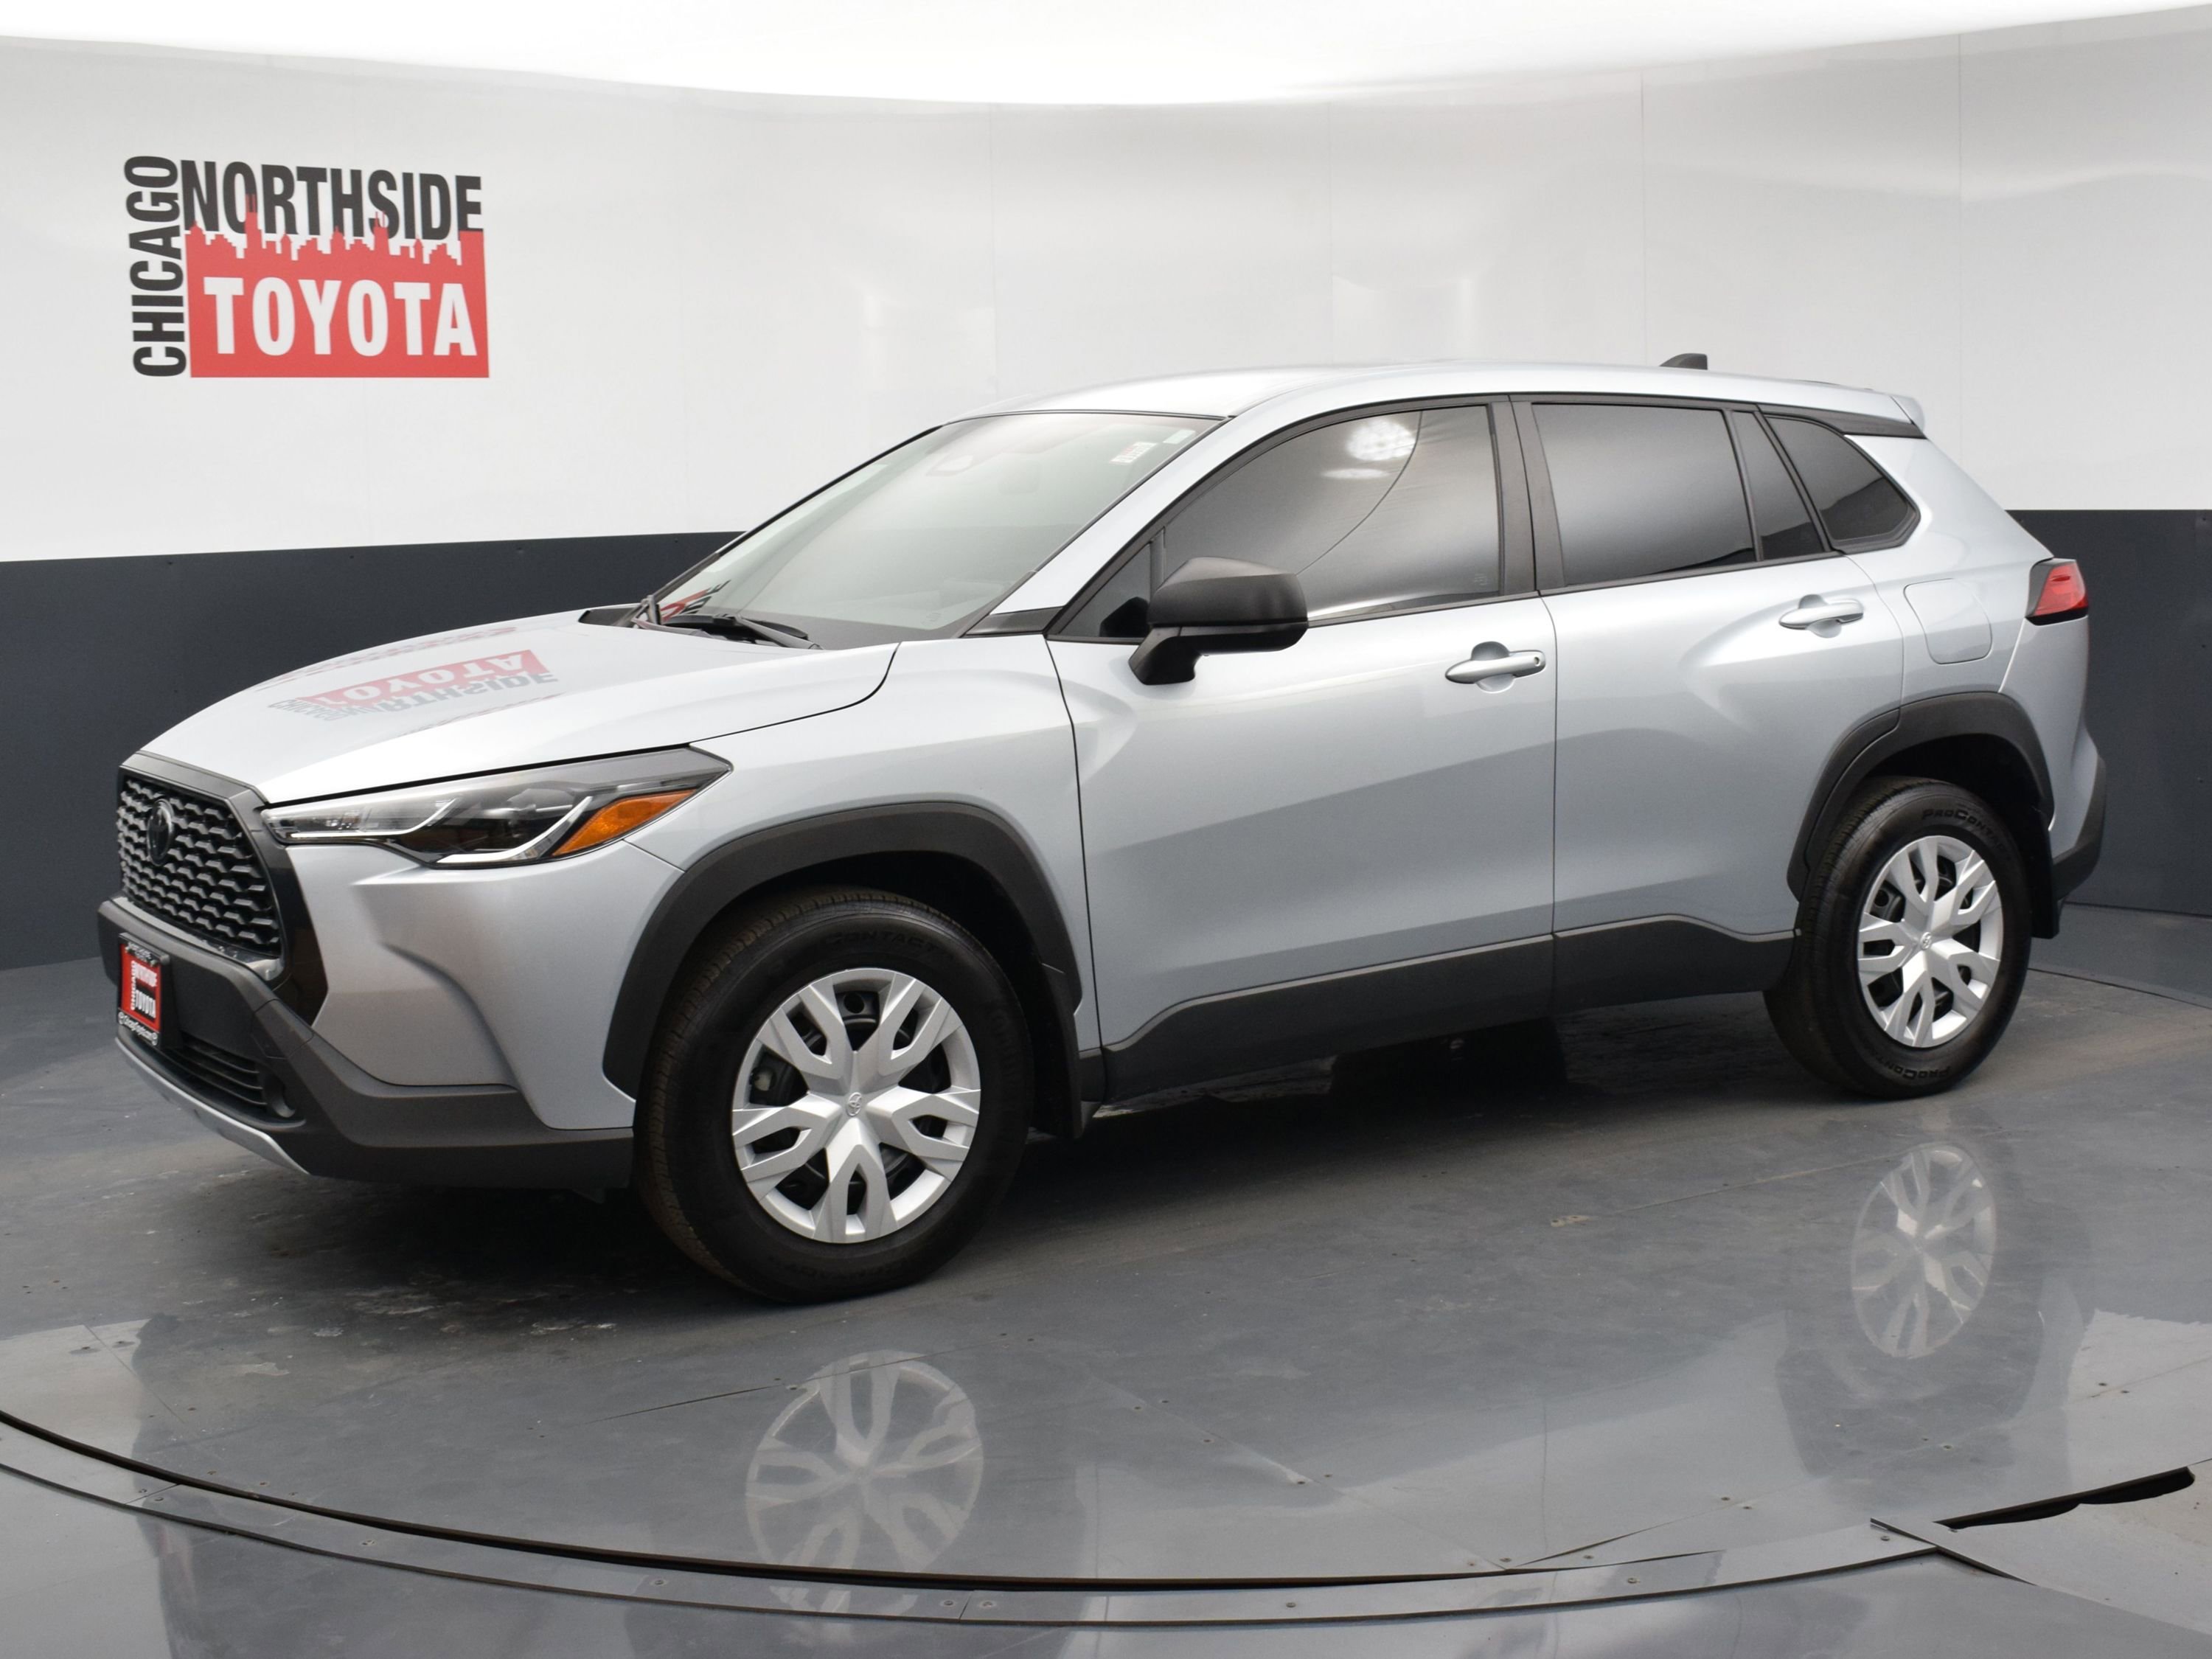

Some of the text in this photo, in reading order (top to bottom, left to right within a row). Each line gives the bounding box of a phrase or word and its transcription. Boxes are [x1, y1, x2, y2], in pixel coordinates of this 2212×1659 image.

[181, 160, 484, 240] NORTHSIDE
[124, 156, 187, 377] CHICAGO
[204, 276, 477, 356] TOYOTA
